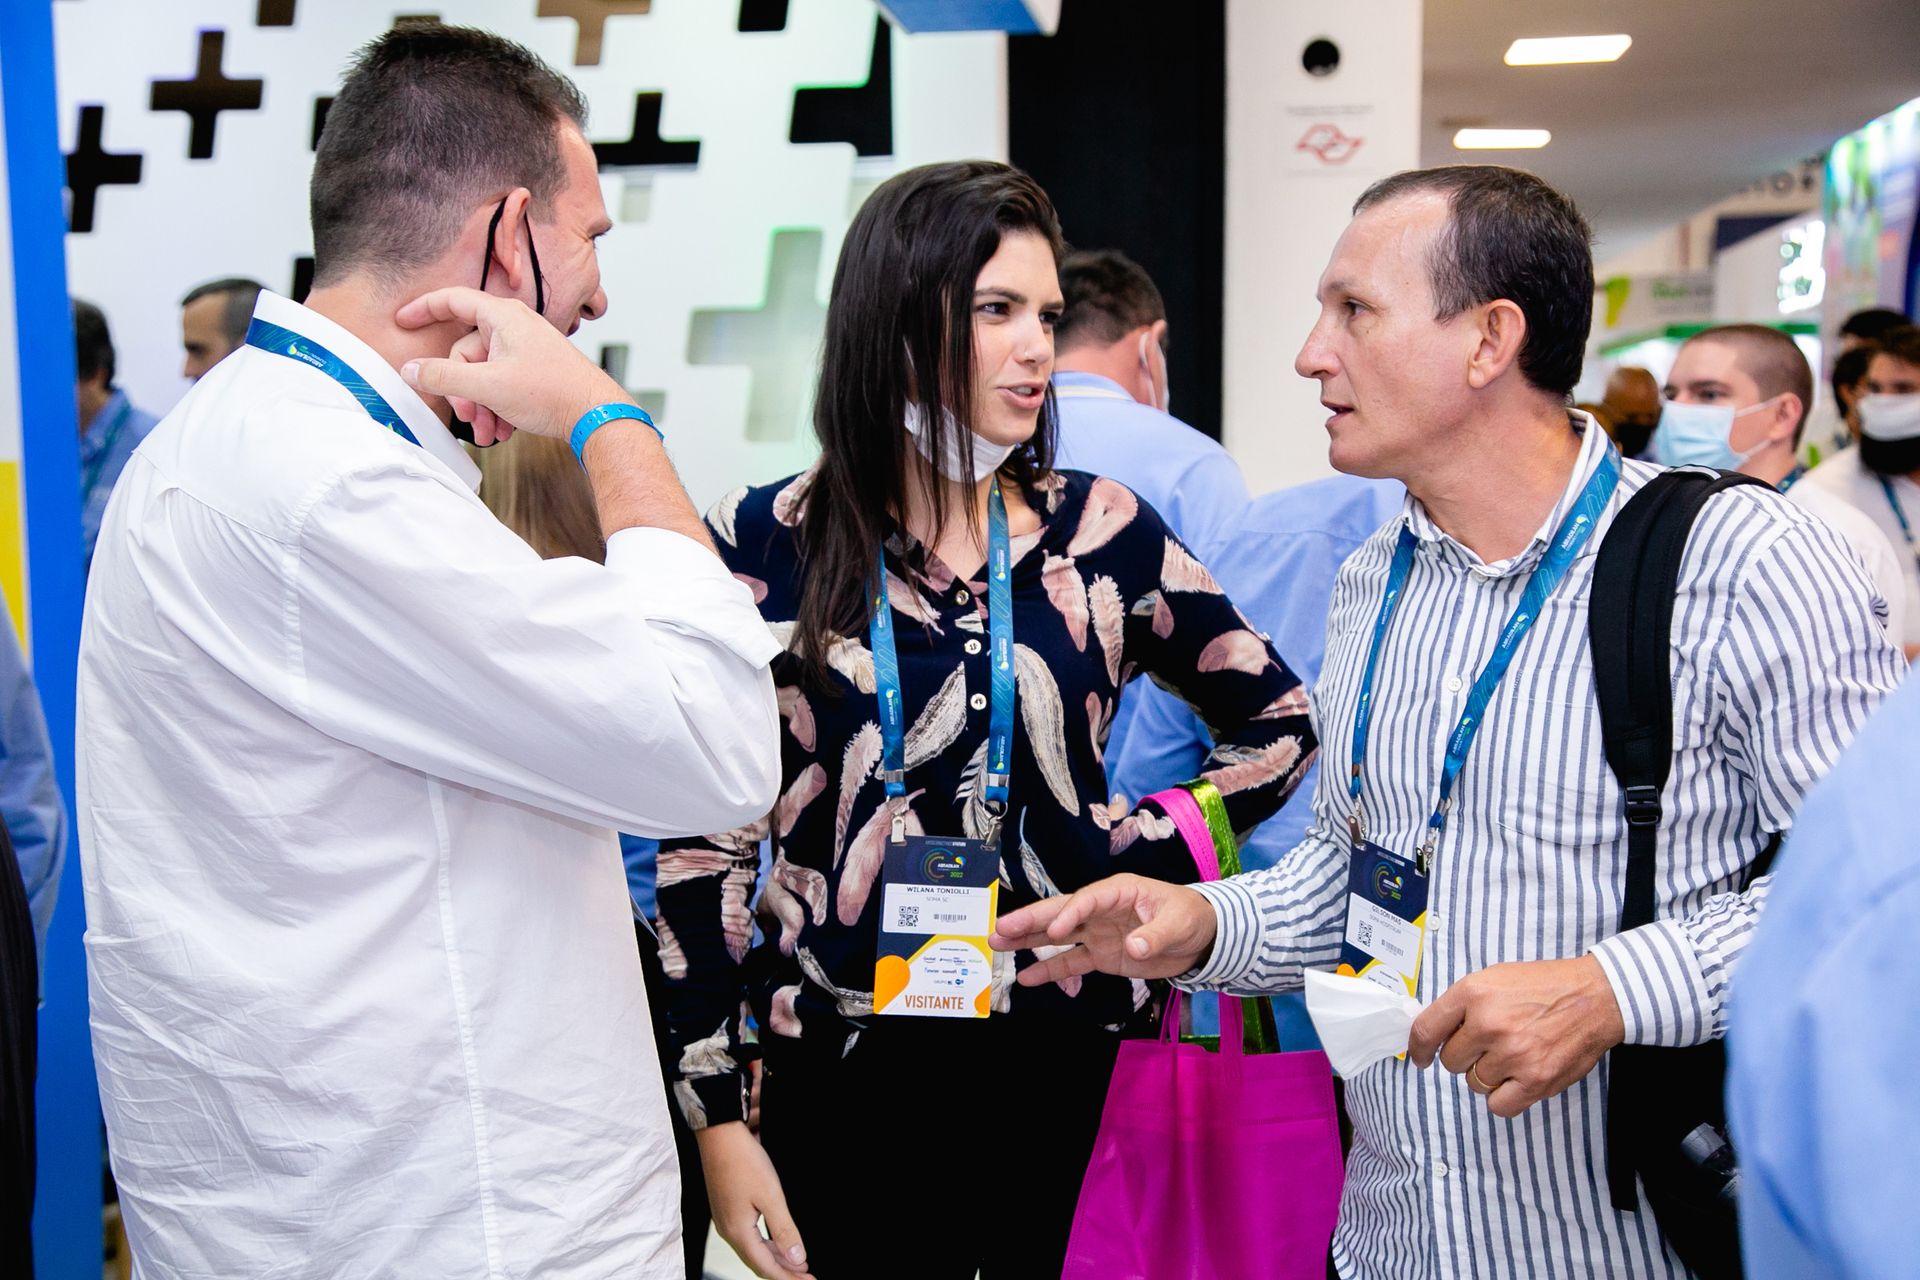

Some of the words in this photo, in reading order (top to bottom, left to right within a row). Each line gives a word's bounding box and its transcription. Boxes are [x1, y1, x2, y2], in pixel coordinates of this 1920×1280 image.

[1560, 522, 1580, 550] ABRADILAN
[1501, 621, 1520, 649] ABRADILAN
[1452, 725, 1466, 754] ABRADILAN
[906, 886, 935, 894] WILANA
[936, 887, 970, 896] TONIOLLI
[904, 995, 965, 1010] VISITANTE
